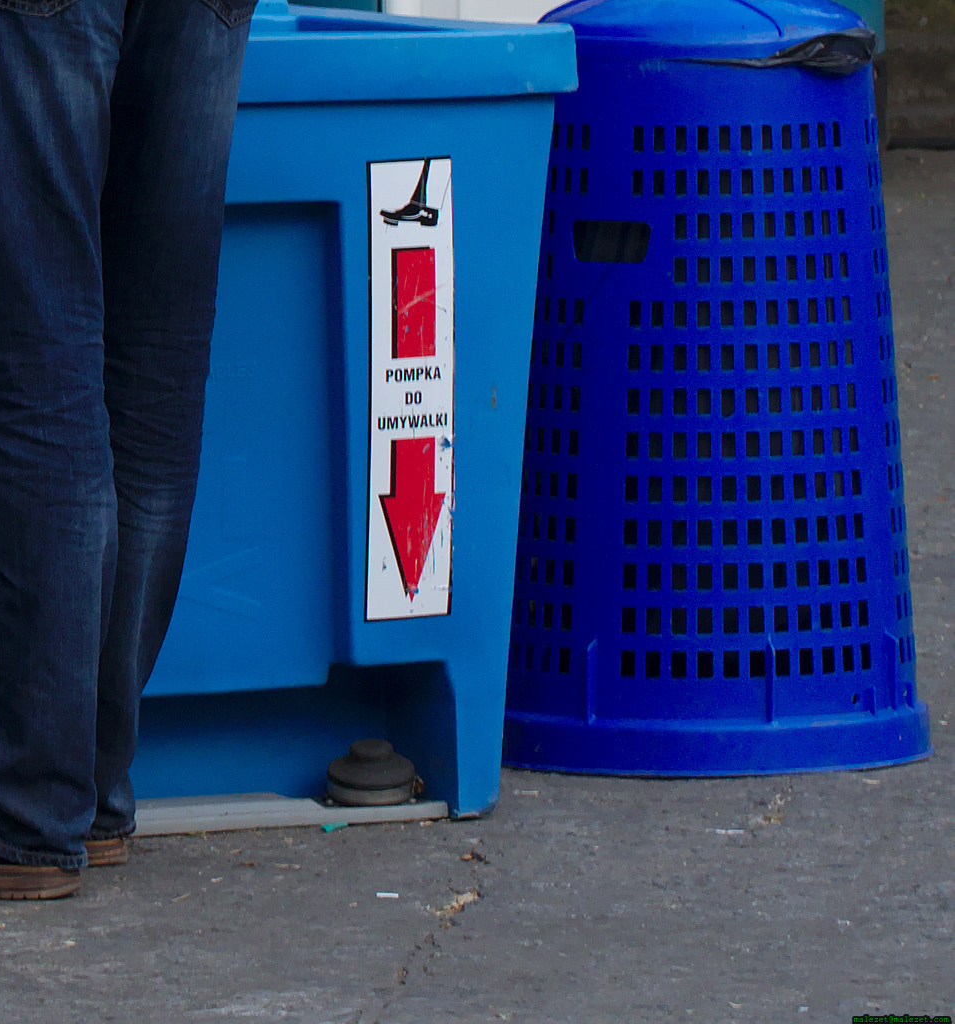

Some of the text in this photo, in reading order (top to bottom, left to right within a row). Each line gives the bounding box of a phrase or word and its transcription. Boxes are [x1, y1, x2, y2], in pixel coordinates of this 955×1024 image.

[385, 365, 442, 383] POMPKA
[404, 390, 423, 405] DO
[377, 412, 448, 430] UMYWALKI
